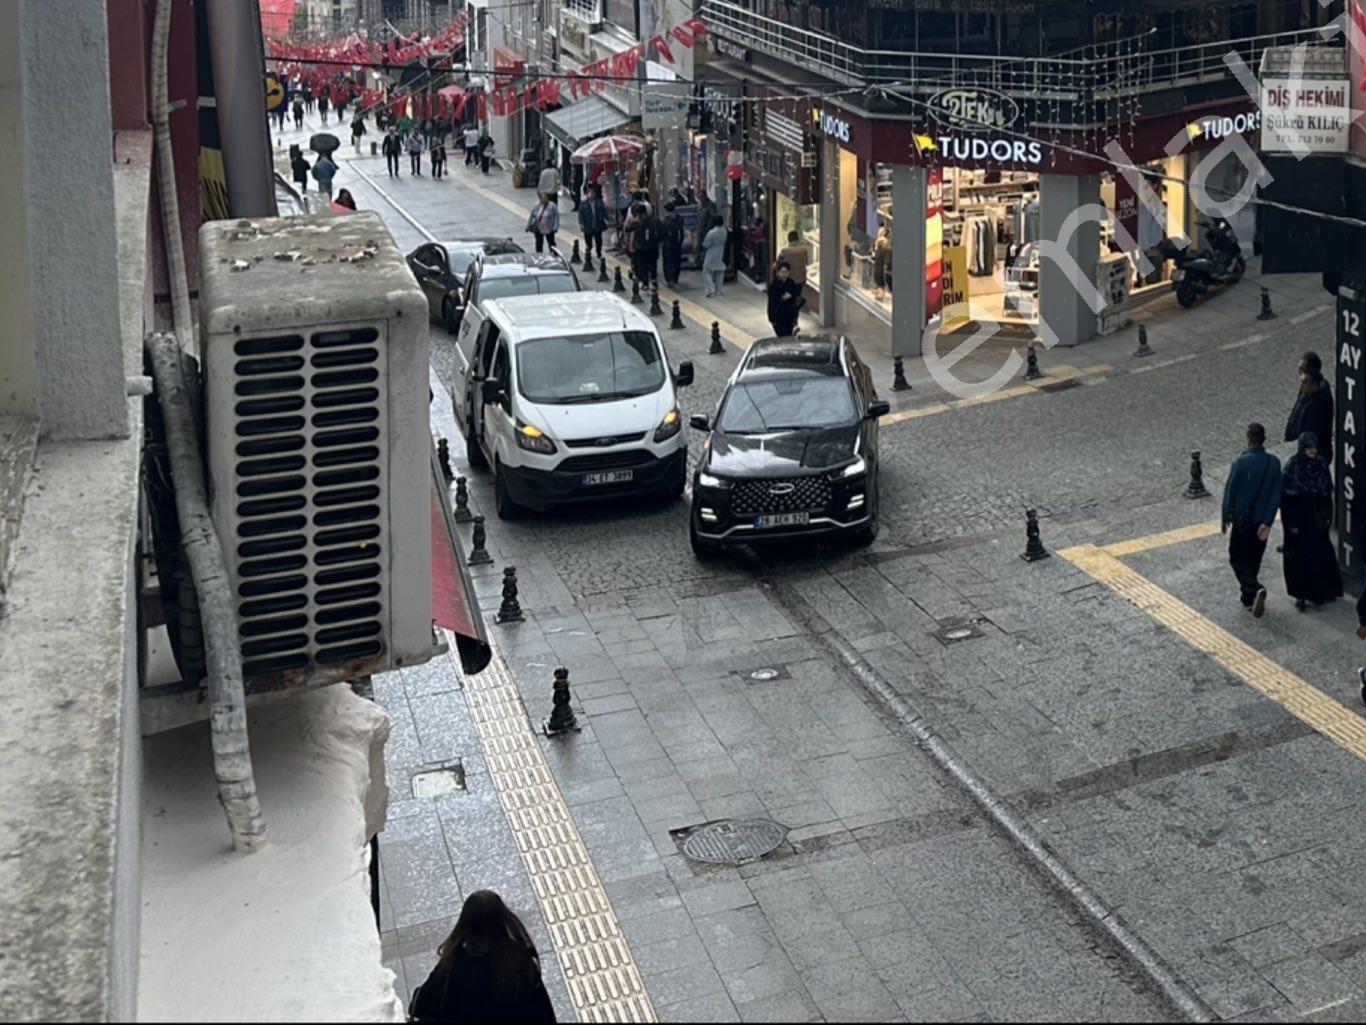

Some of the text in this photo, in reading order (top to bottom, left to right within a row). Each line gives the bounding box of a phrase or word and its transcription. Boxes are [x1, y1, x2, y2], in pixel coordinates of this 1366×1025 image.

[1267, 85, 1345, 110] DİŞ HEKİMİ
[820, 110, 850, 144] TUDORS
[938, 135, 1042, 165] TUDORS
[1342, 309, 1360, 337] 12
[1340, 342, 1362, 370] AY
